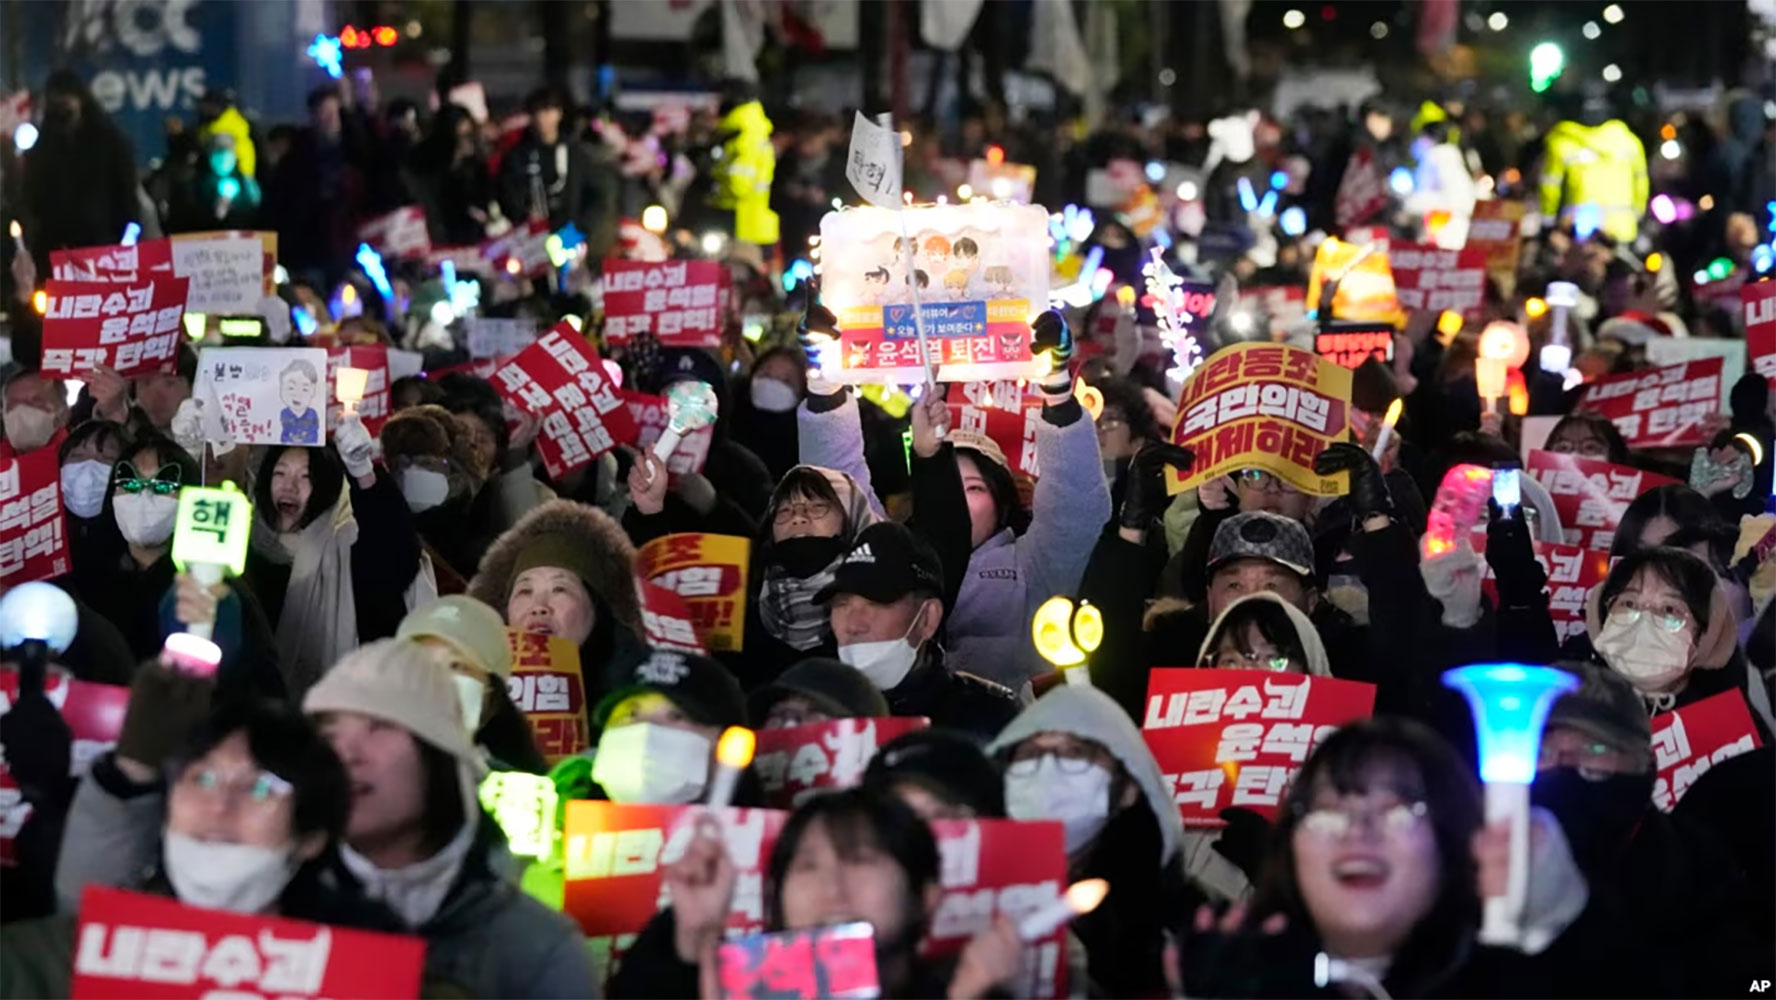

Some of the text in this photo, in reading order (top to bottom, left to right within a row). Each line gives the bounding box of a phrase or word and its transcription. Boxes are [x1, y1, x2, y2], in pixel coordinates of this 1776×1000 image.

[91, 67, 206, 112] ews
[44, 280, 155, 318] 내란수괴
[604, 261, 687, 293] 내란수괴
[644, 284, 717, 312] 윤석열
[99, 304, 183, 345] 윤석열
[42, 331, 180, 374] 즉각 탄핵!
[537, 330, 625, 415] 내란수괴
[876, 335, 997, 366] 윤석열 퇴진
[1177, 347, 1320, 415] 내란동조
[1586, 362, 1689, 401] 내란수괴
[1632, 375, 1718, 412] 윤석열
[496, 362, 591, 468] 즉각 탄핵!
[553, 381, 615, 454] 윤석열
[1183, 383, 1330, 435] 국민의힘
[1611, 413, 1642, 439] 각
[0, 481, 59, 531] 석열
[191, 498, 231, 544] 핵
[507, 674, 570, 711] 의힘
[1143, 674, 1312, 730] 내란수괴
[76, 922, 333, 995] 내란수괴
